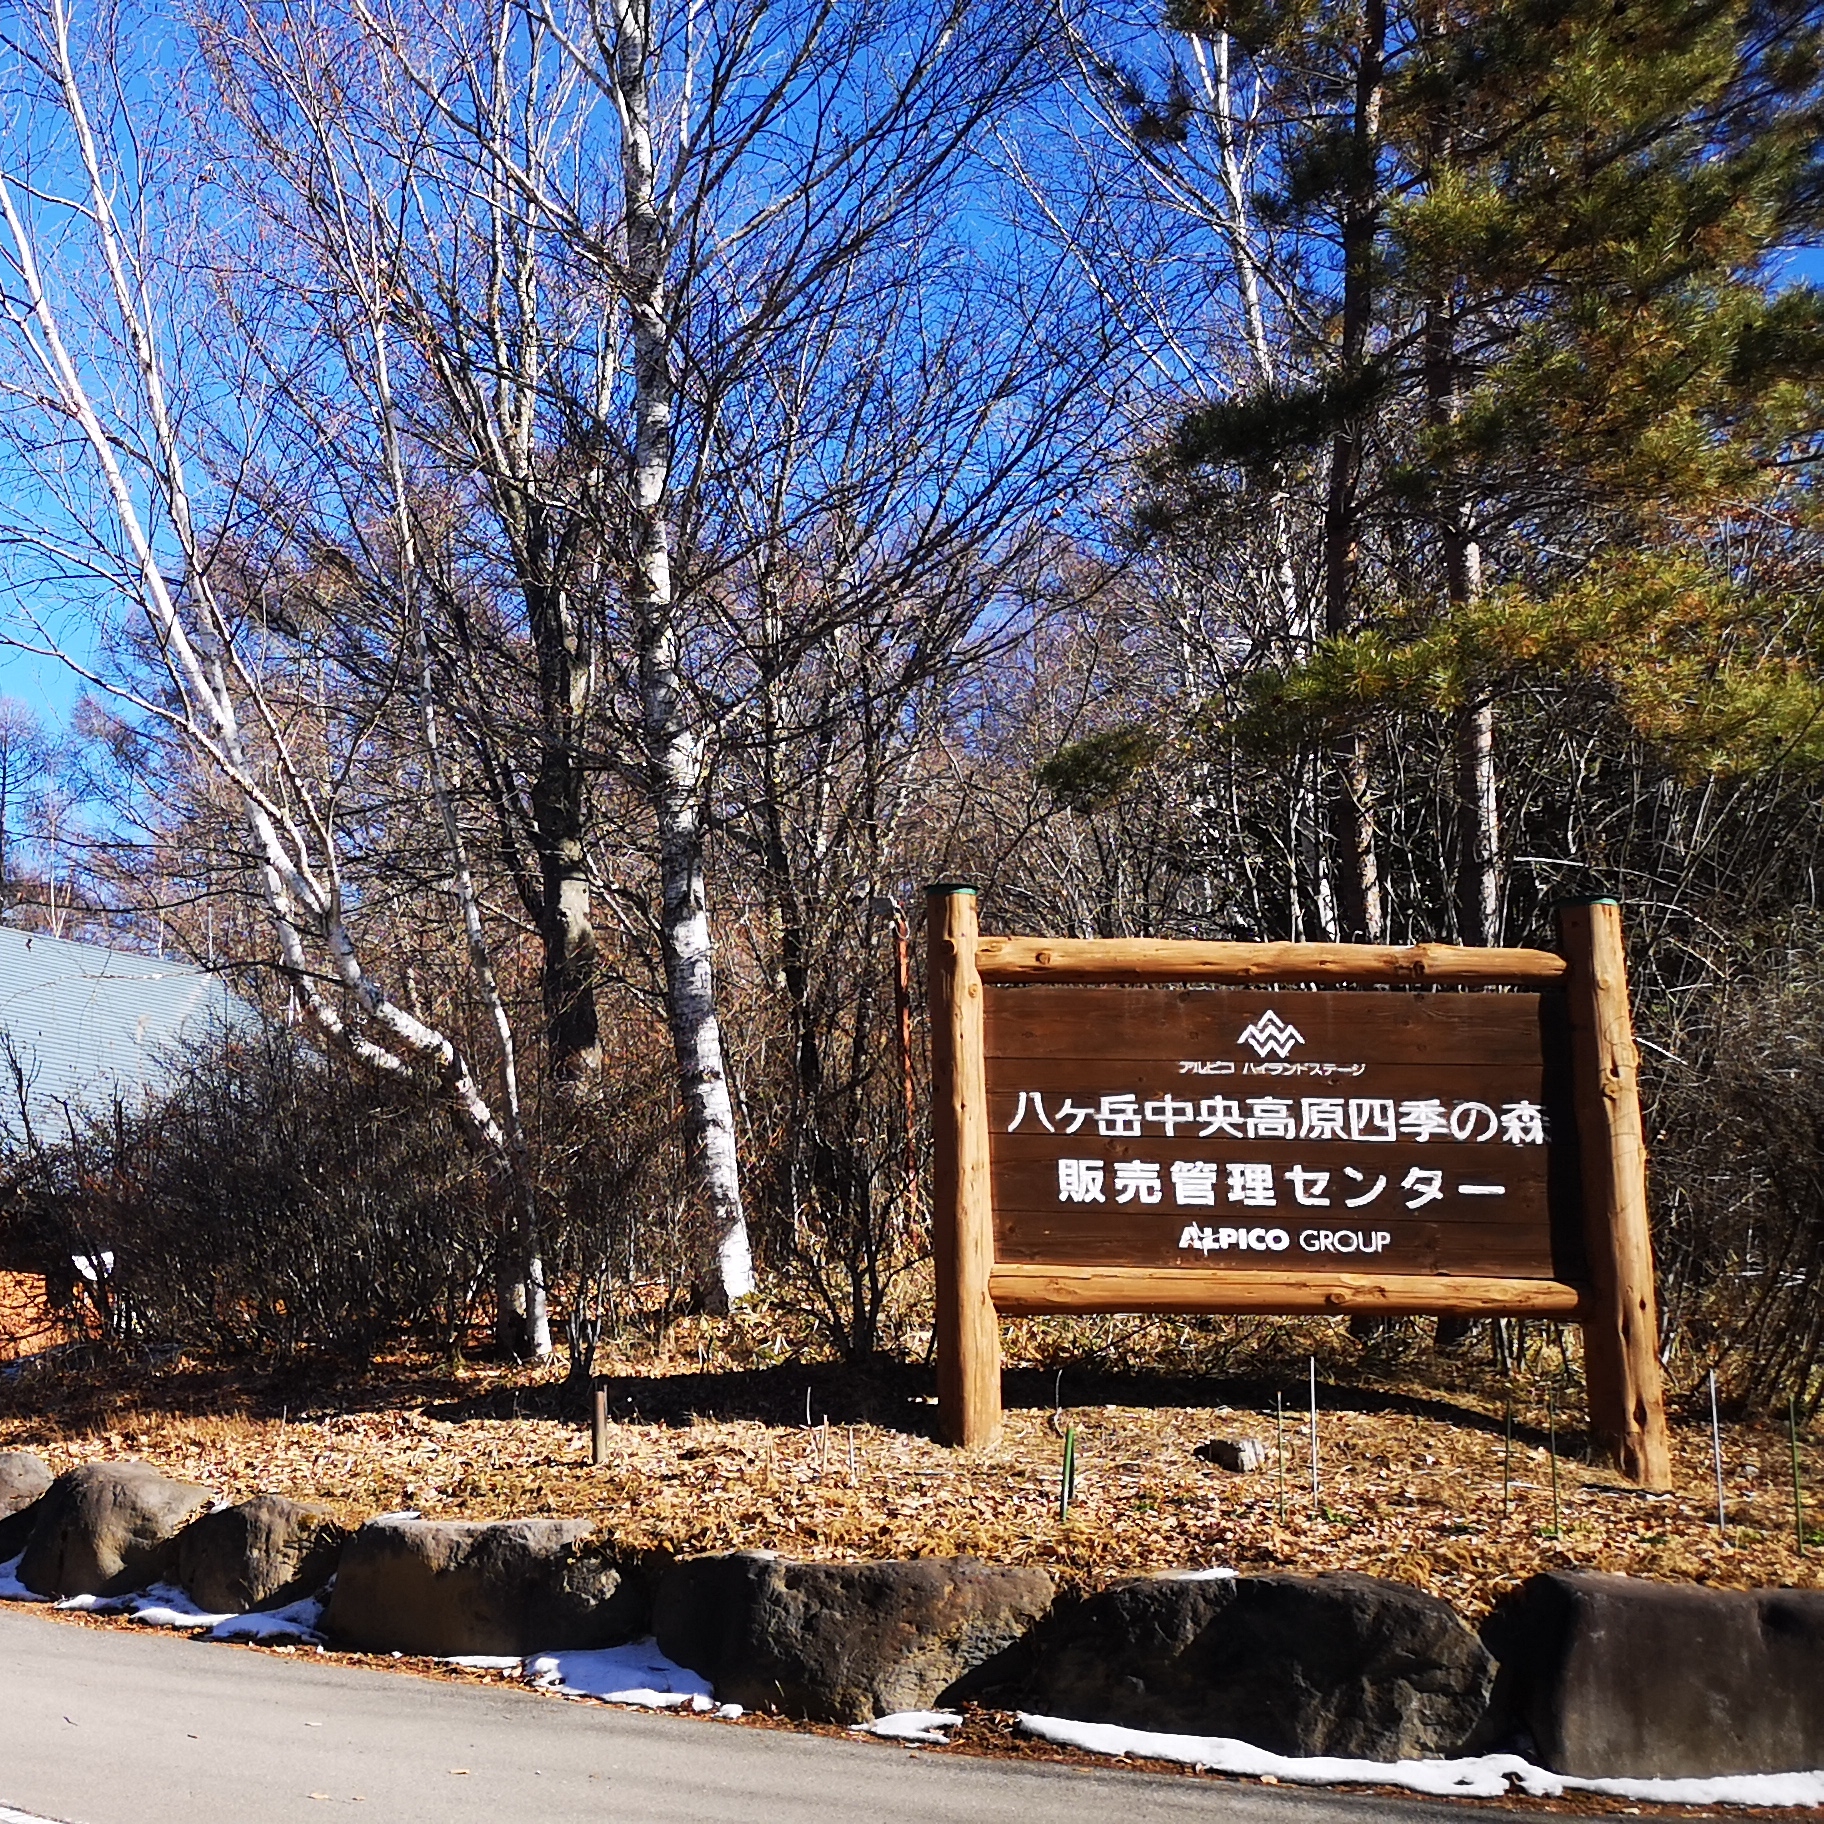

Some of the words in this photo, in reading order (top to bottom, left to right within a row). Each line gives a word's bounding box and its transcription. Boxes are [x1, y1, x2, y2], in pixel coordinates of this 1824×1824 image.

[1242, 1062, 1367, 1076] ハイランドステージ
[1058, 1159, 1506, 1209] 販売管理センター
[1179, 1221, 1290, 1256] ALPICO
[1299, 1230, 1391, 1253] GROUP
